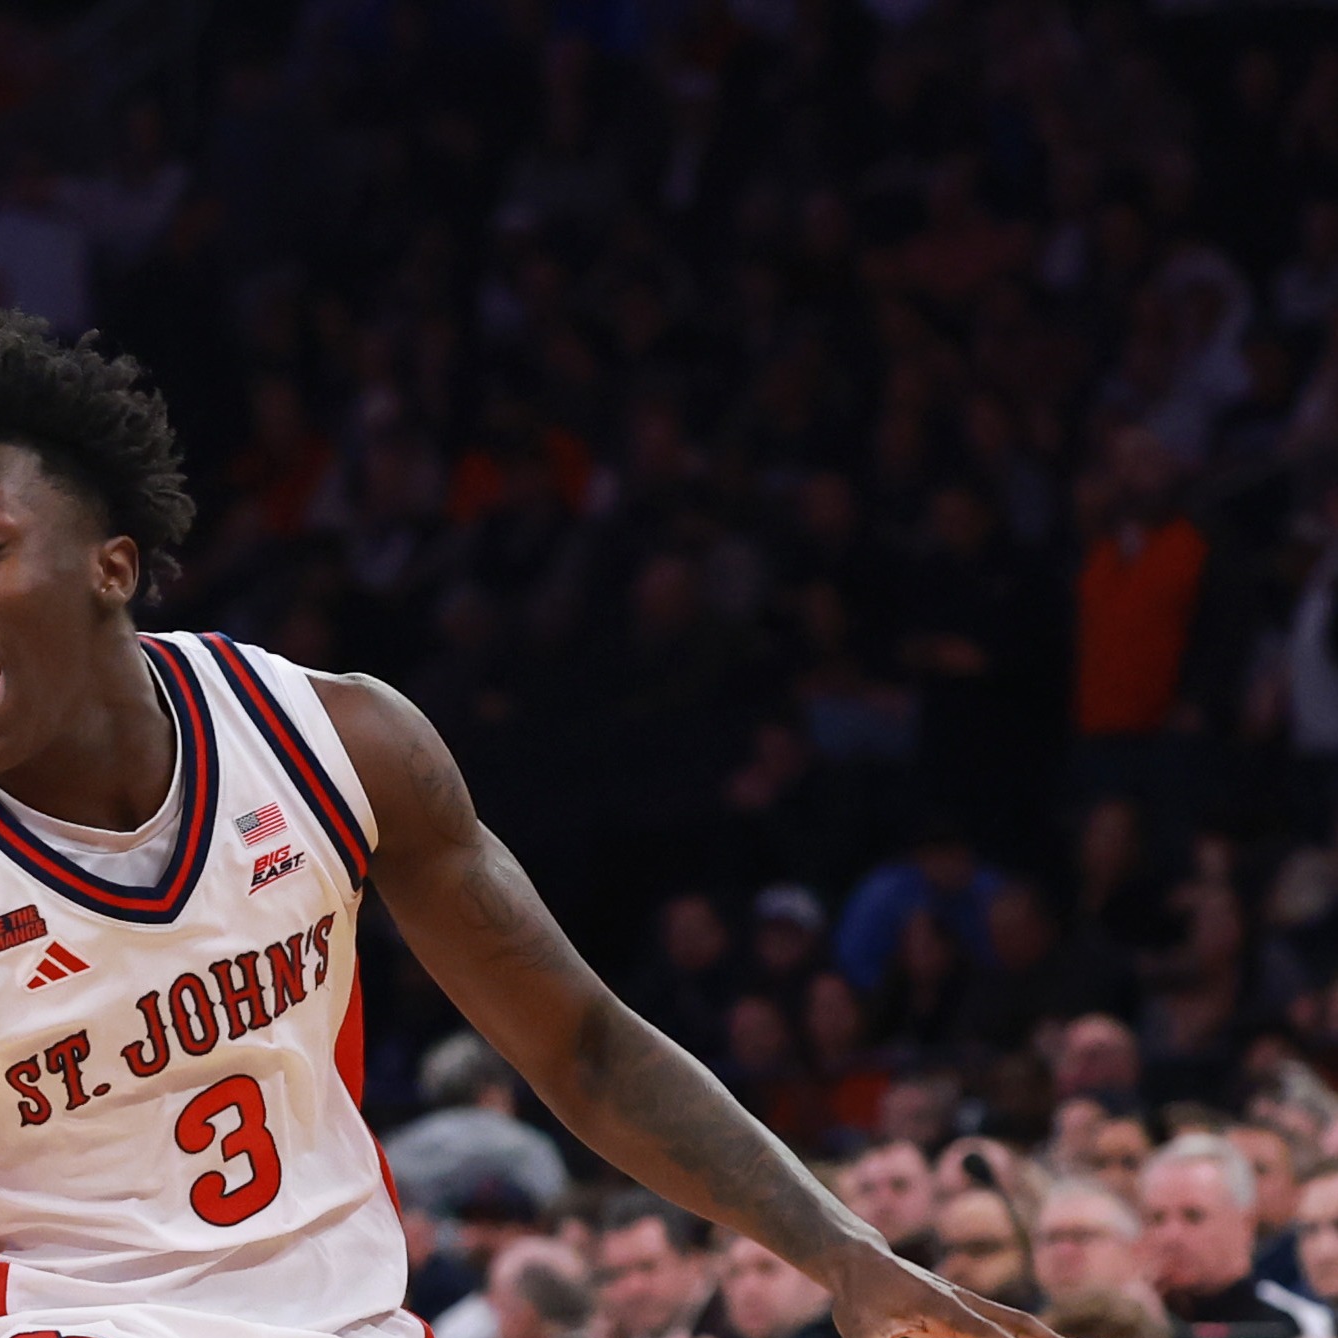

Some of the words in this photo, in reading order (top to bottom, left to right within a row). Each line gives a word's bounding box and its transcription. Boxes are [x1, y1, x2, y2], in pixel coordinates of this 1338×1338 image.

[250, 851, 306, 887] EAST
[253, 844, 291, 874] BIG
[7, 905, 39, 929] THE
[4, 1029, 112, 1128] ST.
[120, 910, 336, 1078] JOHN'S
[174, 1073, 282, 1228] 3
